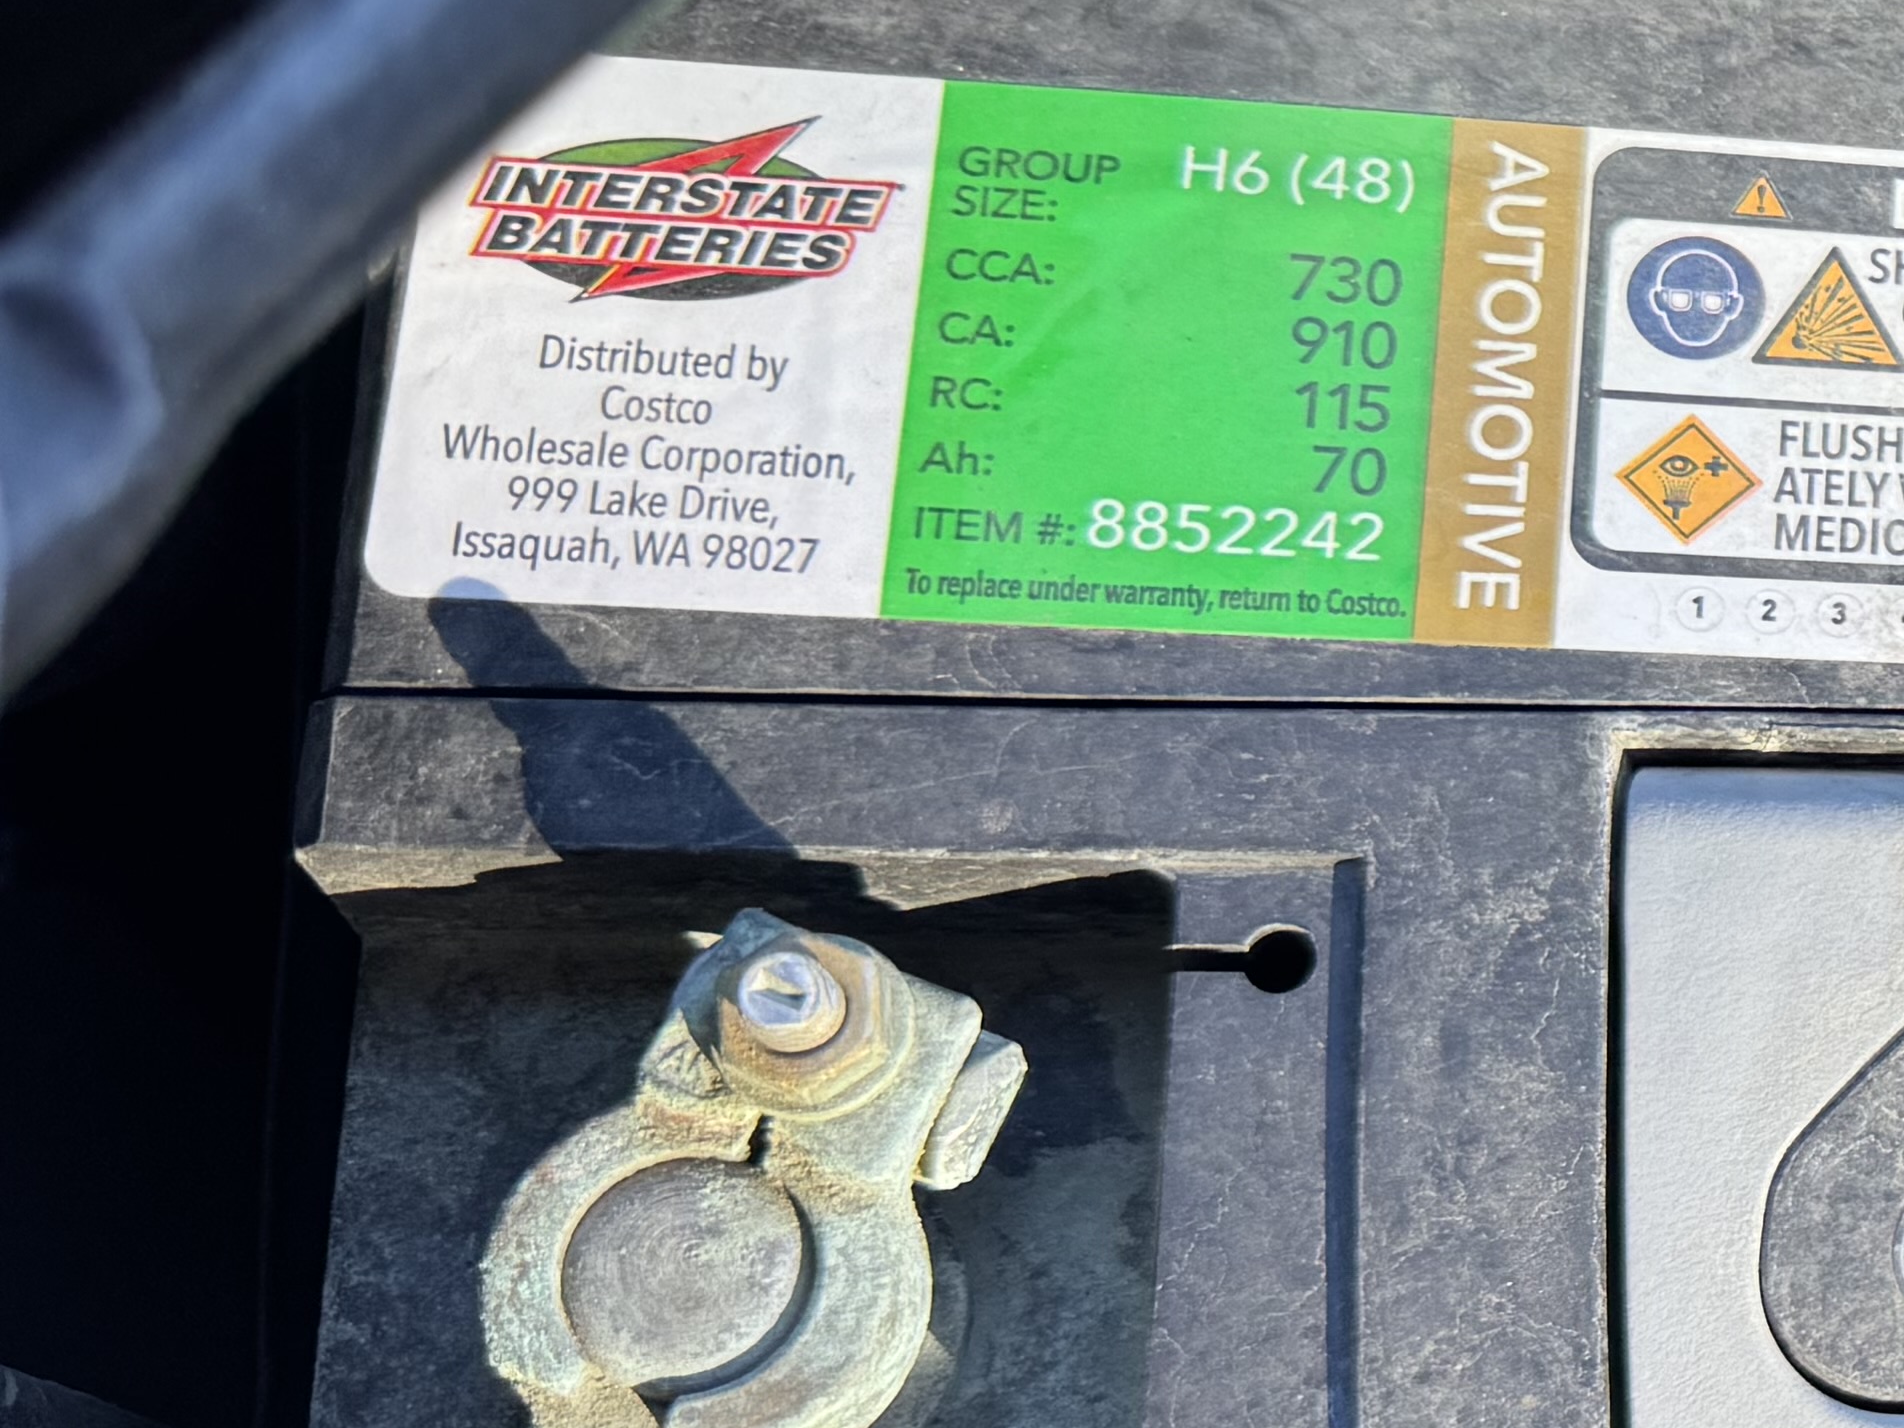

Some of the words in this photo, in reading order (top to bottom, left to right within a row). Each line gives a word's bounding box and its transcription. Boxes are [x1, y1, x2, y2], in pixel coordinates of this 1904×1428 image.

[957, 146, 1122, 185] GROUP
[1180, 147, 1270, 194] H6
[1290, 152, 1415, 213] (48)
[482, 164, 885, 227] INTERSTATE
[952, 185, 1058, 222] SIZE:
[485, 214, 852, 272] BATTERIES
[946, 248, 1055, 286] CCA:
[1289, 253, 1404, 308] 730
[538, 334, 735, 380] Distributed
[747, 345, 790, 391] by
[938, 312, 1015, 349] CA:
[1290, 316, 1398, 369] 910
[1455, 139, 1550, 611] AUTOMOTIVE
[600, 386, 714, 426] Costco
[929, 377, 1003, 413] RC:
[1295, 381, 1391, 434] 115
[442, 423, 630, 470] Wholesale
[640, 434, 856, 485] Corporation,
[918, 442, 994, 478] Ah:
[1311, 446, 1388, 497] 70
[1779, 419, 1903, 465] FLUSH
[507, 475, 579, 514] 999
[590, 481, 668, 520] Lake
[679, 486, 778, 530] Drive,
[1773, 466, 1889, 511] ATELY
[451, 521, 620, 572] Issaquah,
[633, 531, 691, 569] WA
[703, 534, 819, 574] 98027
[913, 506, 1023, 546] ITEM
[1037, 514, 1076, 548] #:
[1087, 499, 1384, 562] 8852242
[905, 568, 932, 597] To
[937, 572, 1022, 605] replace
[1027, 574, 1099, 605] under
[1105, 582, 1213, 616] warranty,
[1218, 586, 1292, 615] return
[1297, 589, 1321, 615] to
[1325, 589, 1406, 620] Costco.
[1692, 596, 1705, 619] 1
[1761, 599, 1777, 623] 2
[1831, 602, 1847, 625] 3
